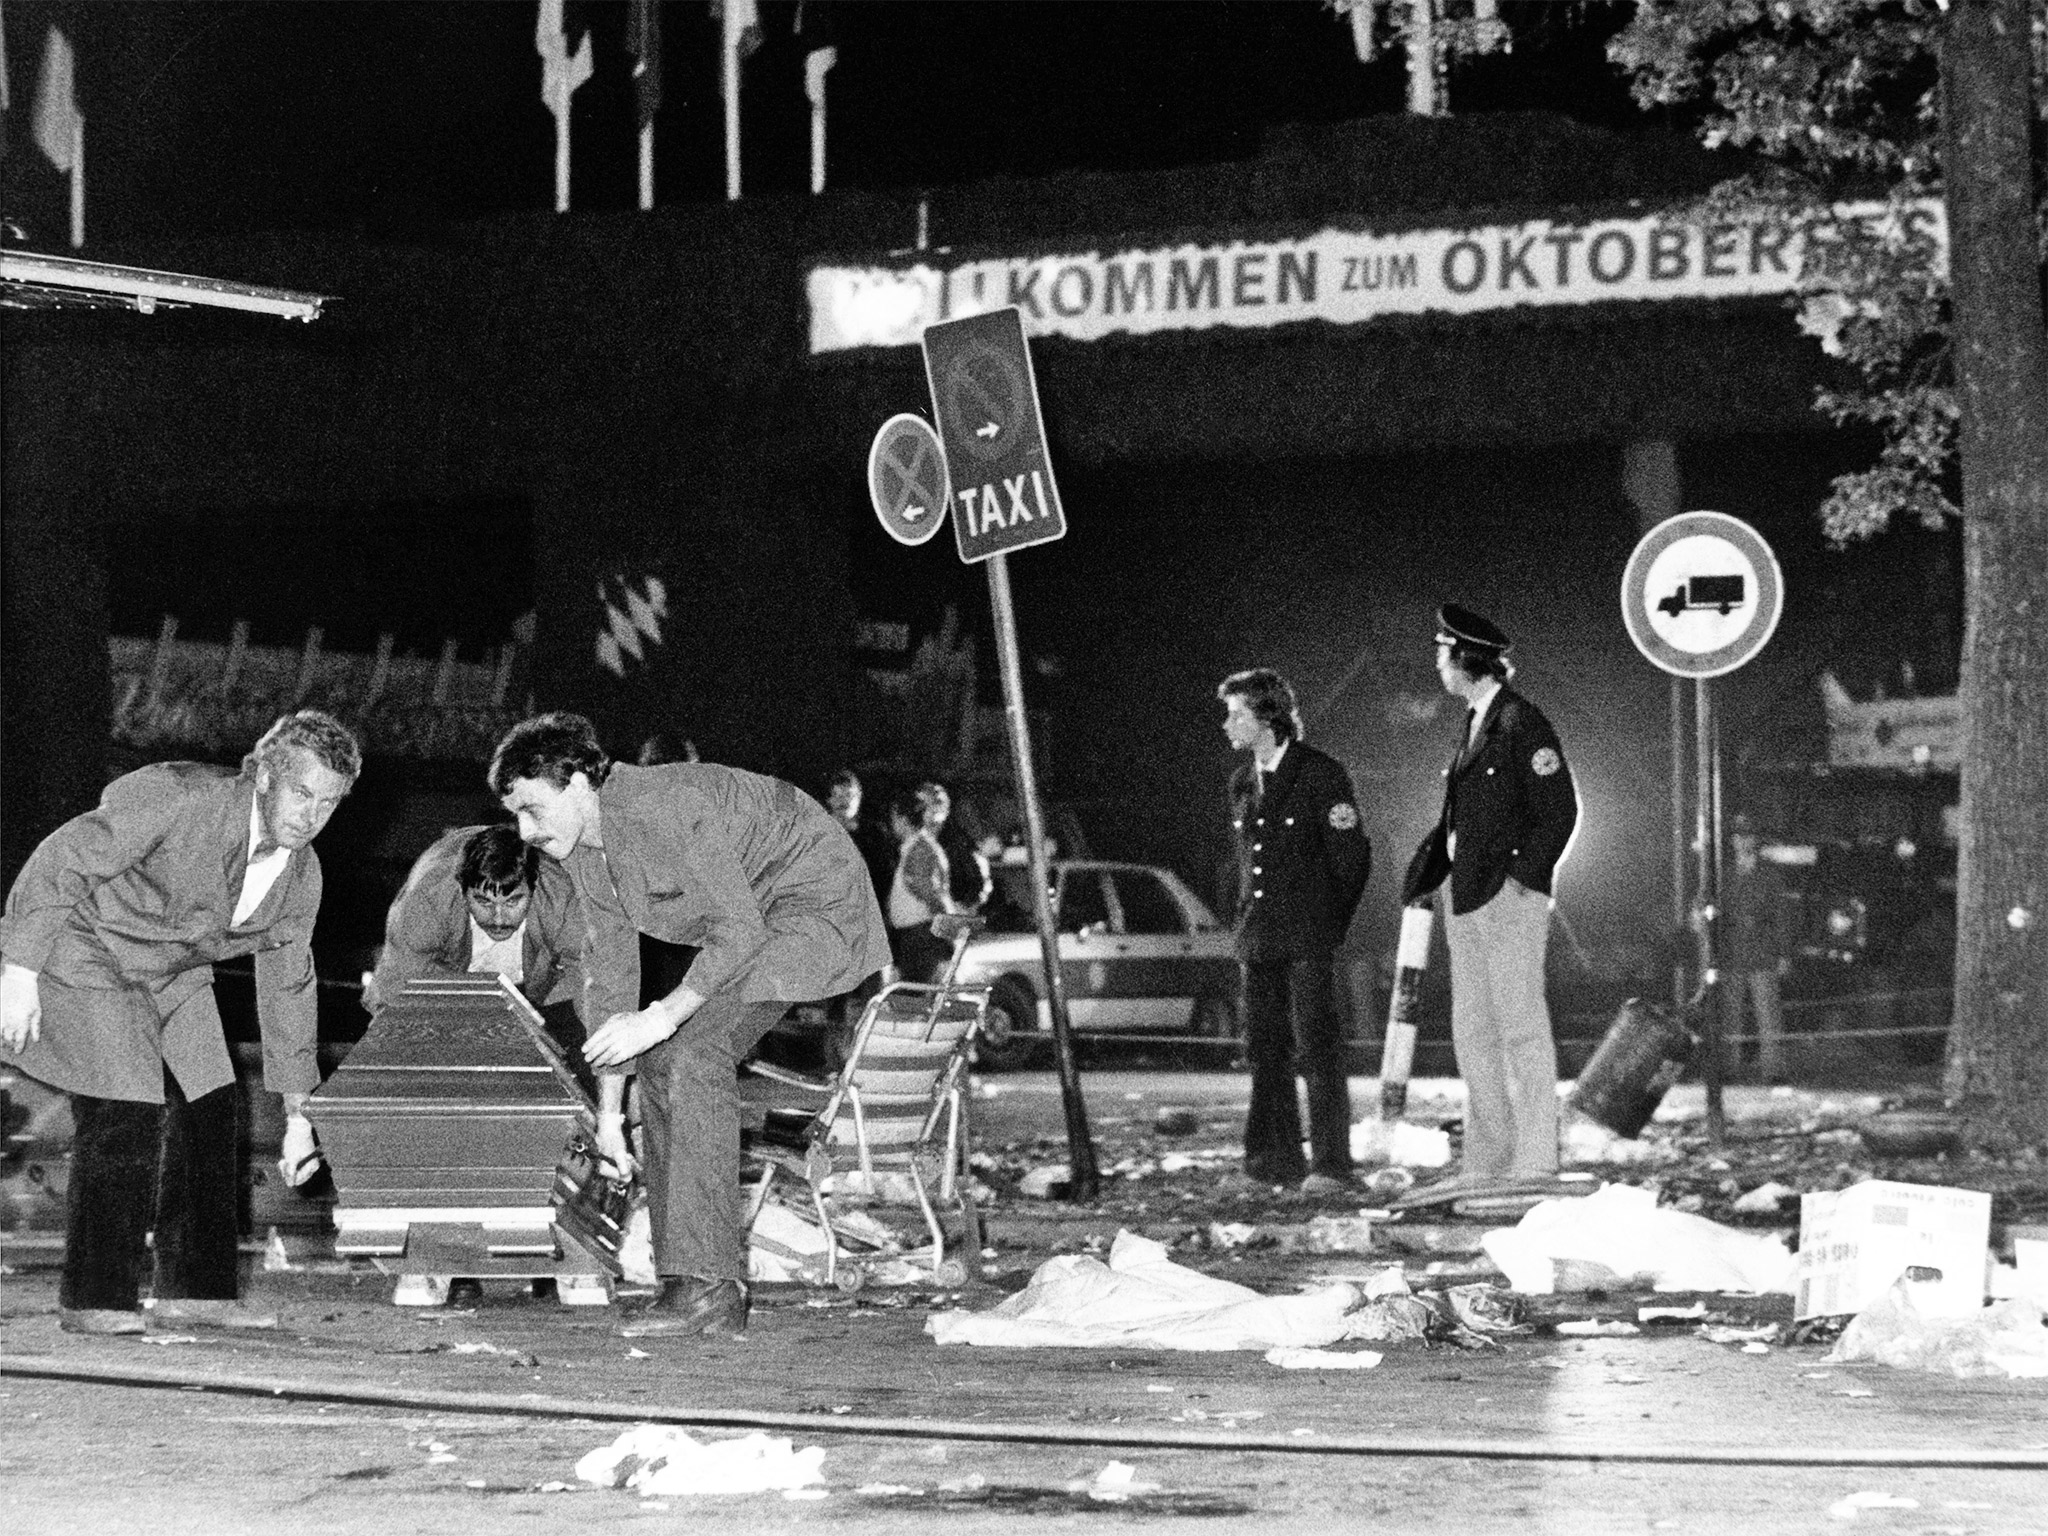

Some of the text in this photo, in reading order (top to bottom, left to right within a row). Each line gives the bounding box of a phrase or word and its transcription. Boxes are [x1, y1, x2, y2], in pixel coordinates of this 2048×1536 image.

[850, 251, 1318, 322] KOMMEN
[1341, 253, 1418, 290] ZUM
[958, 470, 1048, 537] TAXI
